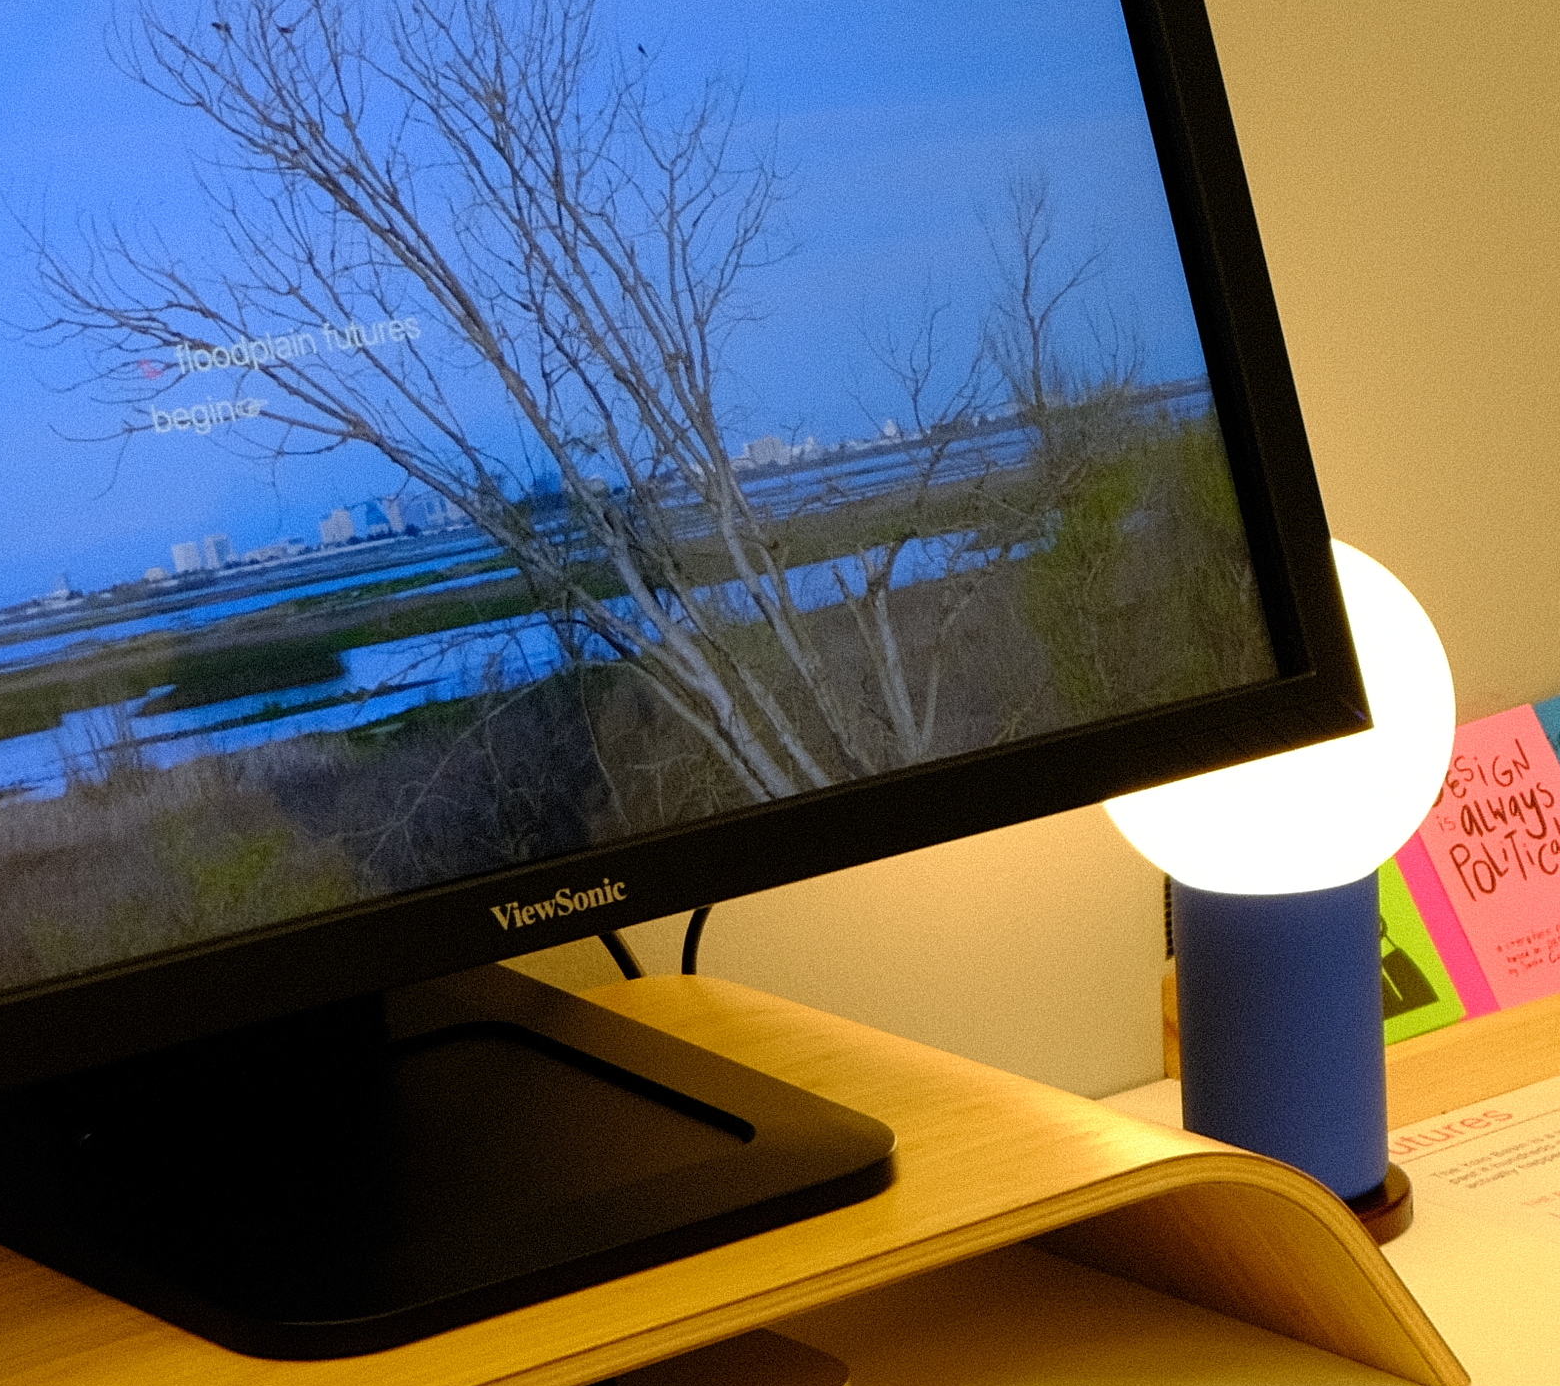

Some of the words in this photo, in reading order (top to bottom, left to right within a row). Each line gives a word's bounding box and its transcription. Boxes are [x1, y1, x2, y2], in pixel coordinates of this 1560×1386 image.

[175, 330, 316, 375] floodplain
[322, 314, 422, 352] futures
[491, 878, 628, 930] ViewSonic
[1388, 1108, 1513, 1156] utures
